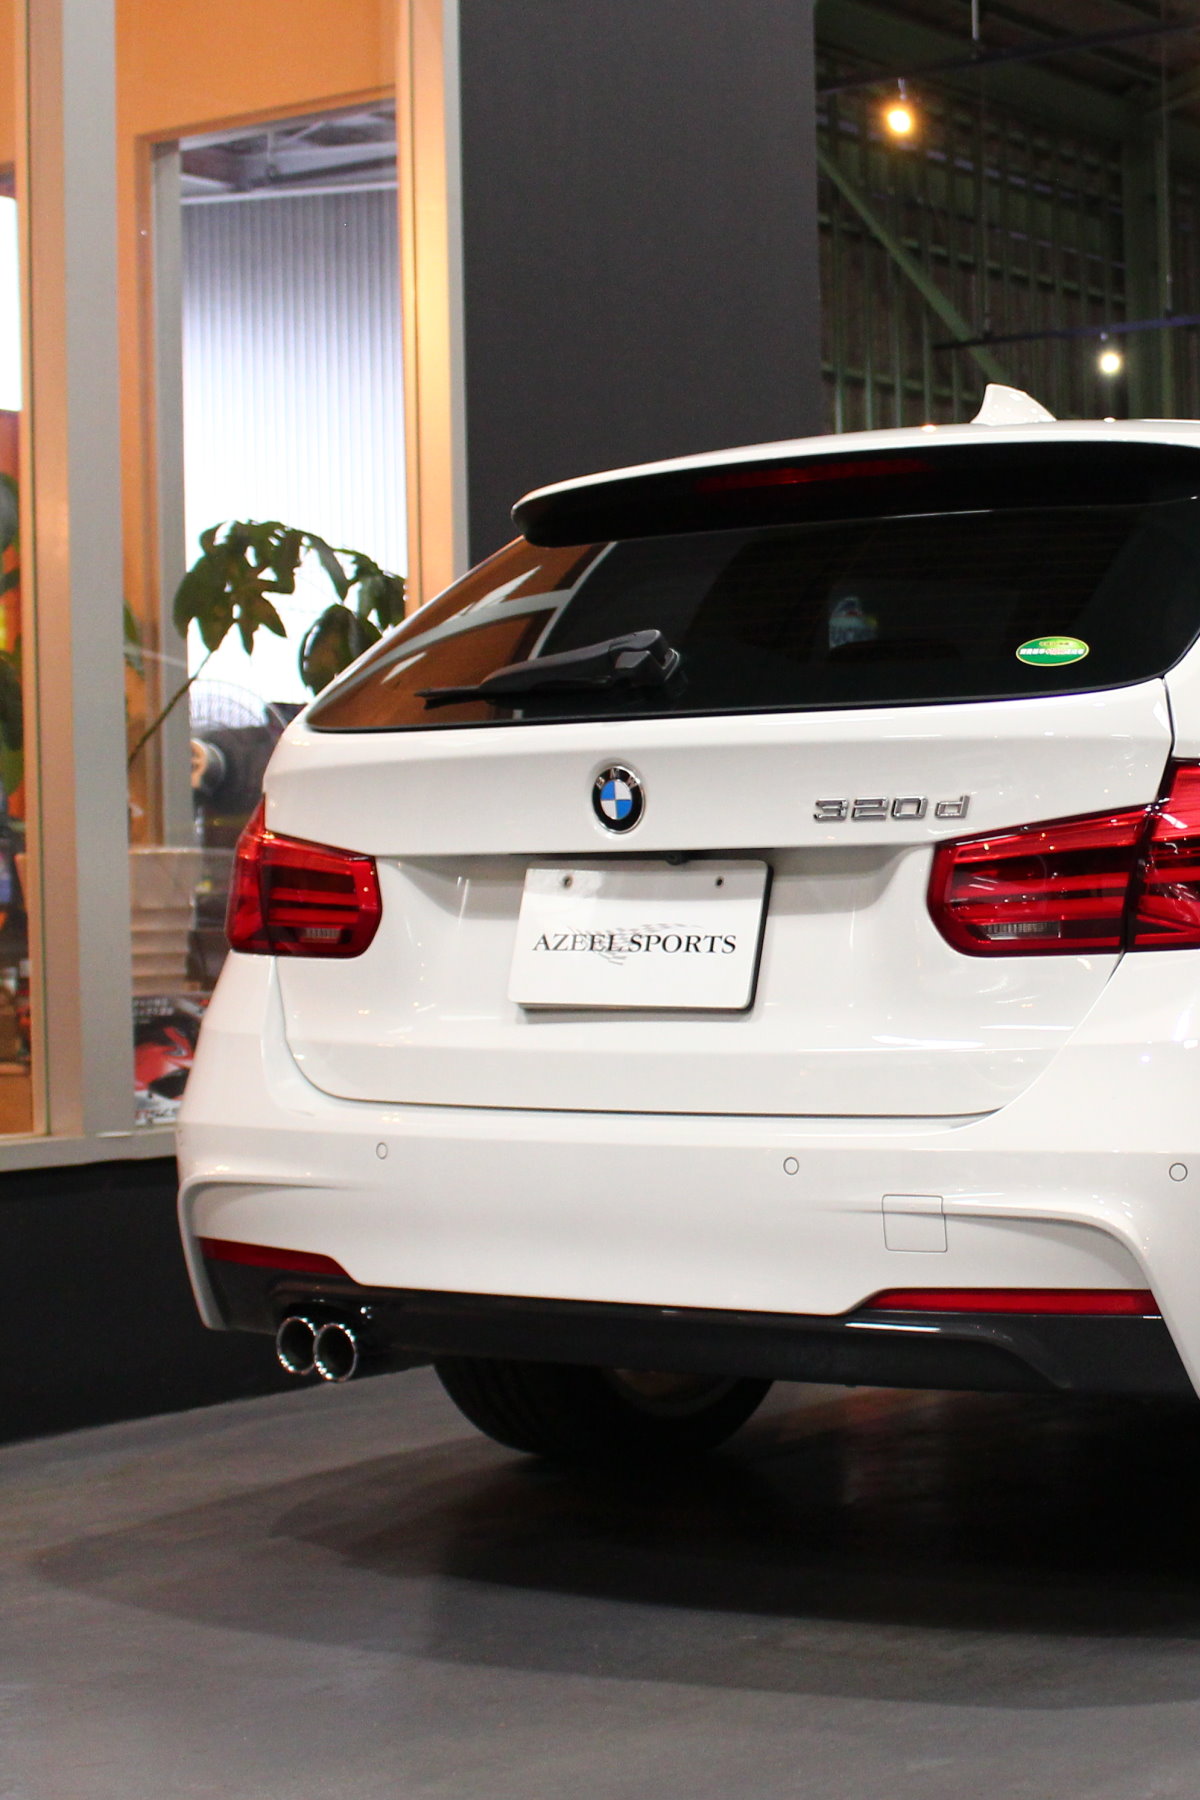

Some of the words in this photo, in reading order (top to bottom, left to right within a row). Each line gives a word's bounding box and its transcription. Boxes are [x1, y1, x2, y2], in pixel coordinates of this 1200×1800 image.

[594, 767, 639, 790] BMW
[532, 933, 623, 952] AZEEL
[627, 933, 737, 954] SPORTS
